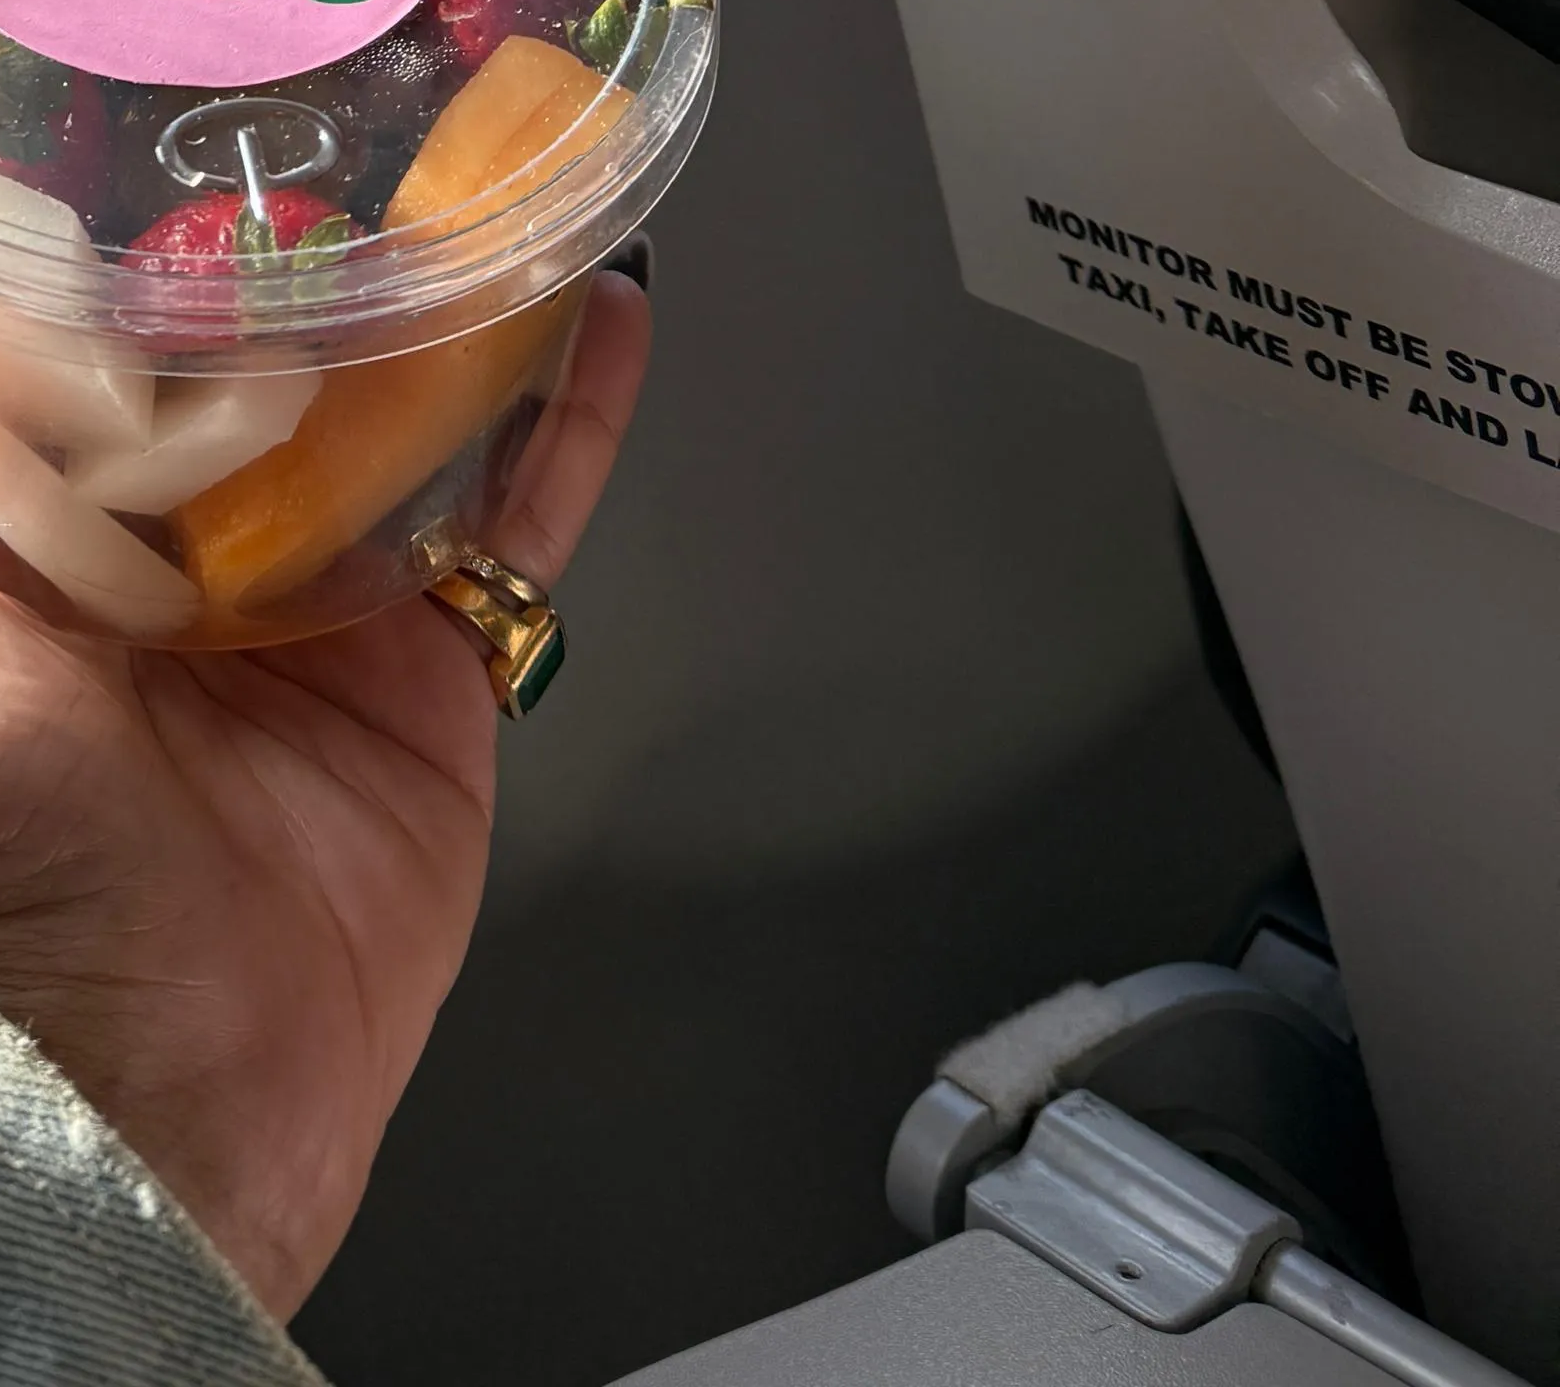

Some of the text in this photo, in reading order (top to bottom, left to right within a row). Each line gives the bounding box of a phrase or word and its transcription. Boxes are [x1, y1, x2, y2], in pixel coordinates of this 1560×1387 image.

[1025, 196, 1217, 291] MONITOR
[1226, 269, 1352, 339] MUST
[1367, 320, 1432, 369] BE
[1058, 253, 1560, 469] TAXI, TAKE OFF AND L
